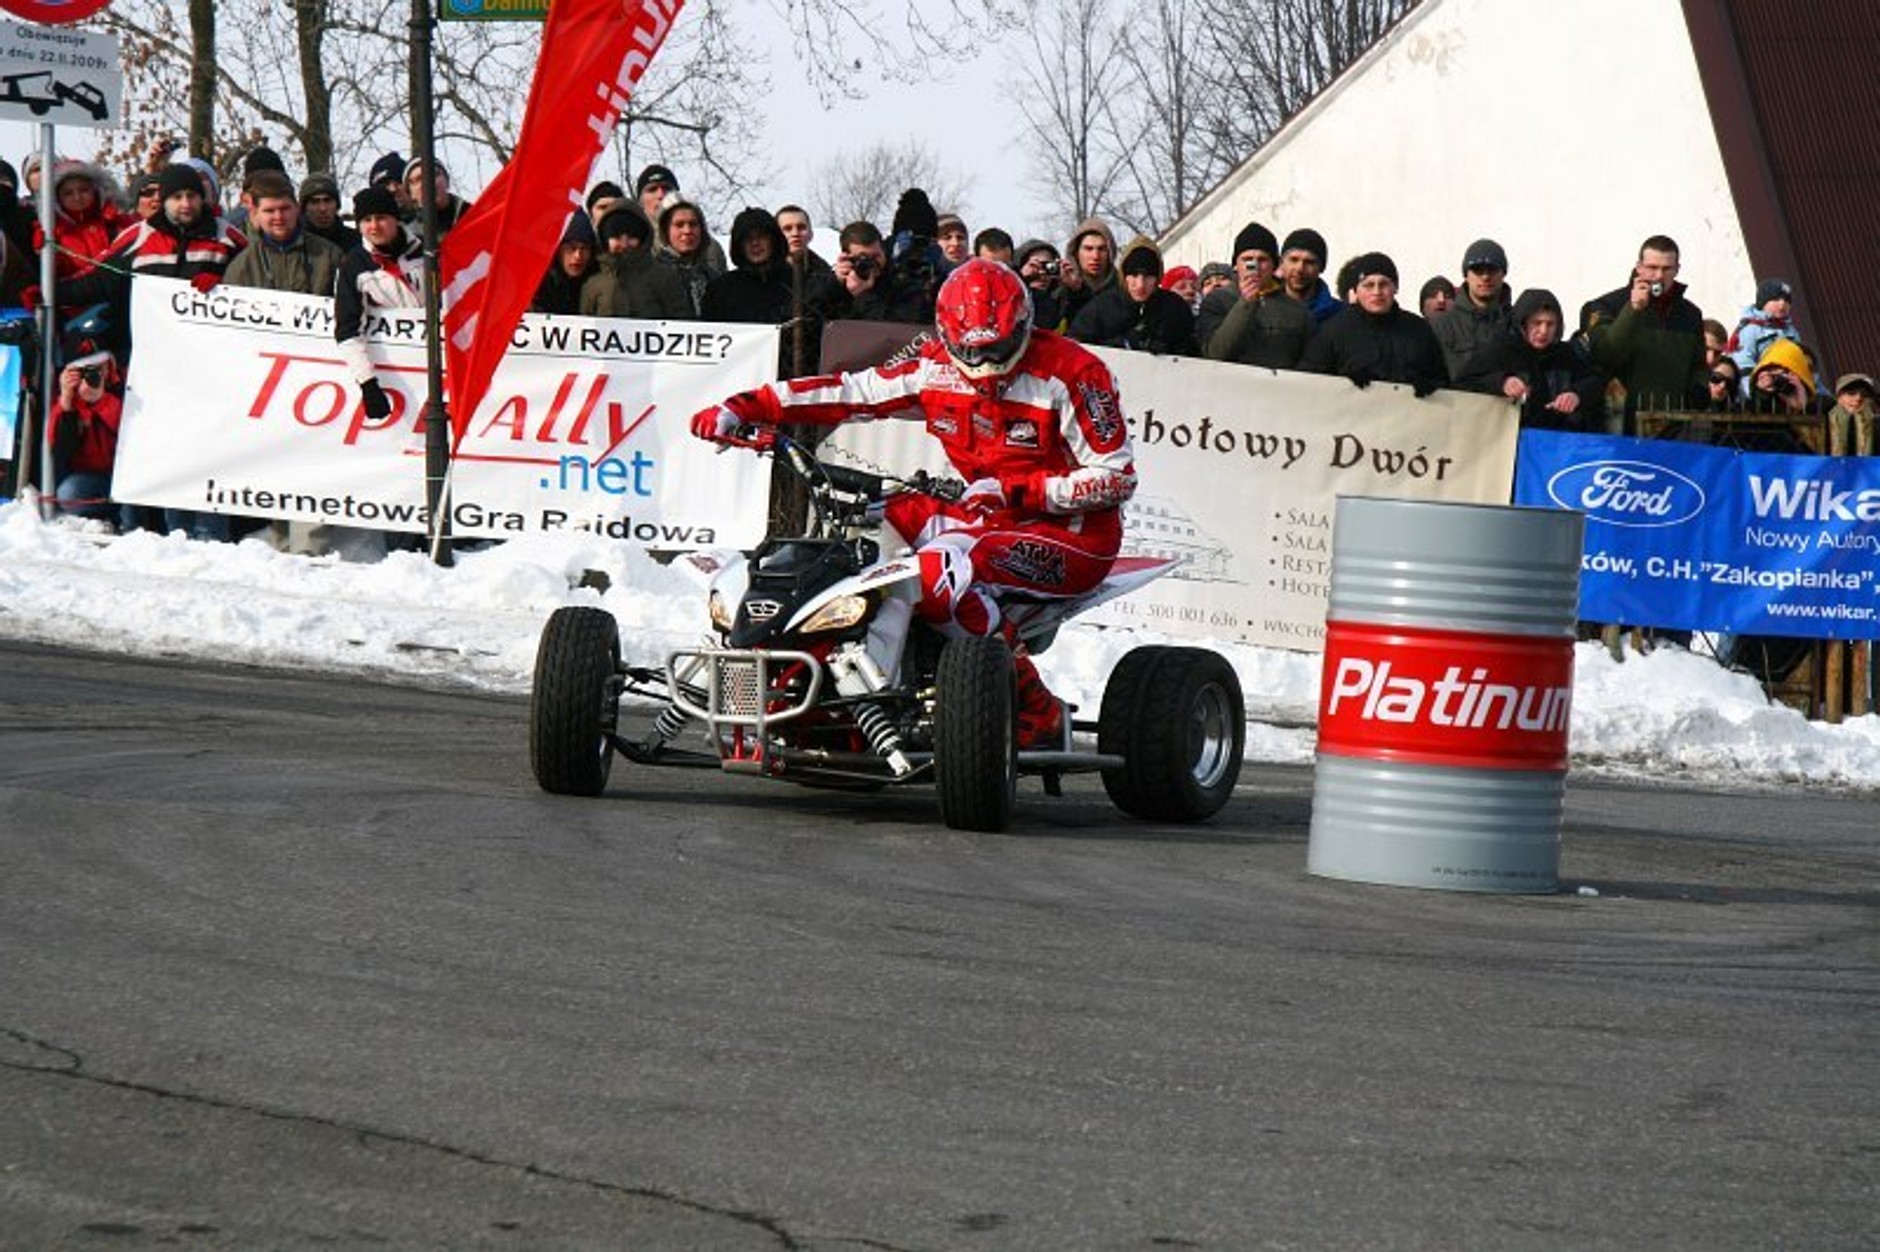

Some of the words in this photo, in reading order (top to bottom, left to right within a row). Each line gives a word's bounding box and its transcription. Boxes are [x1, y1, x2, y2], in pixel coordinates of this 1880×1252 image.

[541, 326, 570, 351] W
[580, 328, 733, 358] RAJDZIE?
[1330, 432, 1453, 481] Dwór
[1580, 466, 1675, 517] Ford
[1748, 475, 1880, 522] Wika
[453, 503, 525, 532] Gra
[1286, 507, 1329, 529] SALA
[1283, 531, 1327, 553] SALA
[1745, 526, 1810, 554] Nowy
